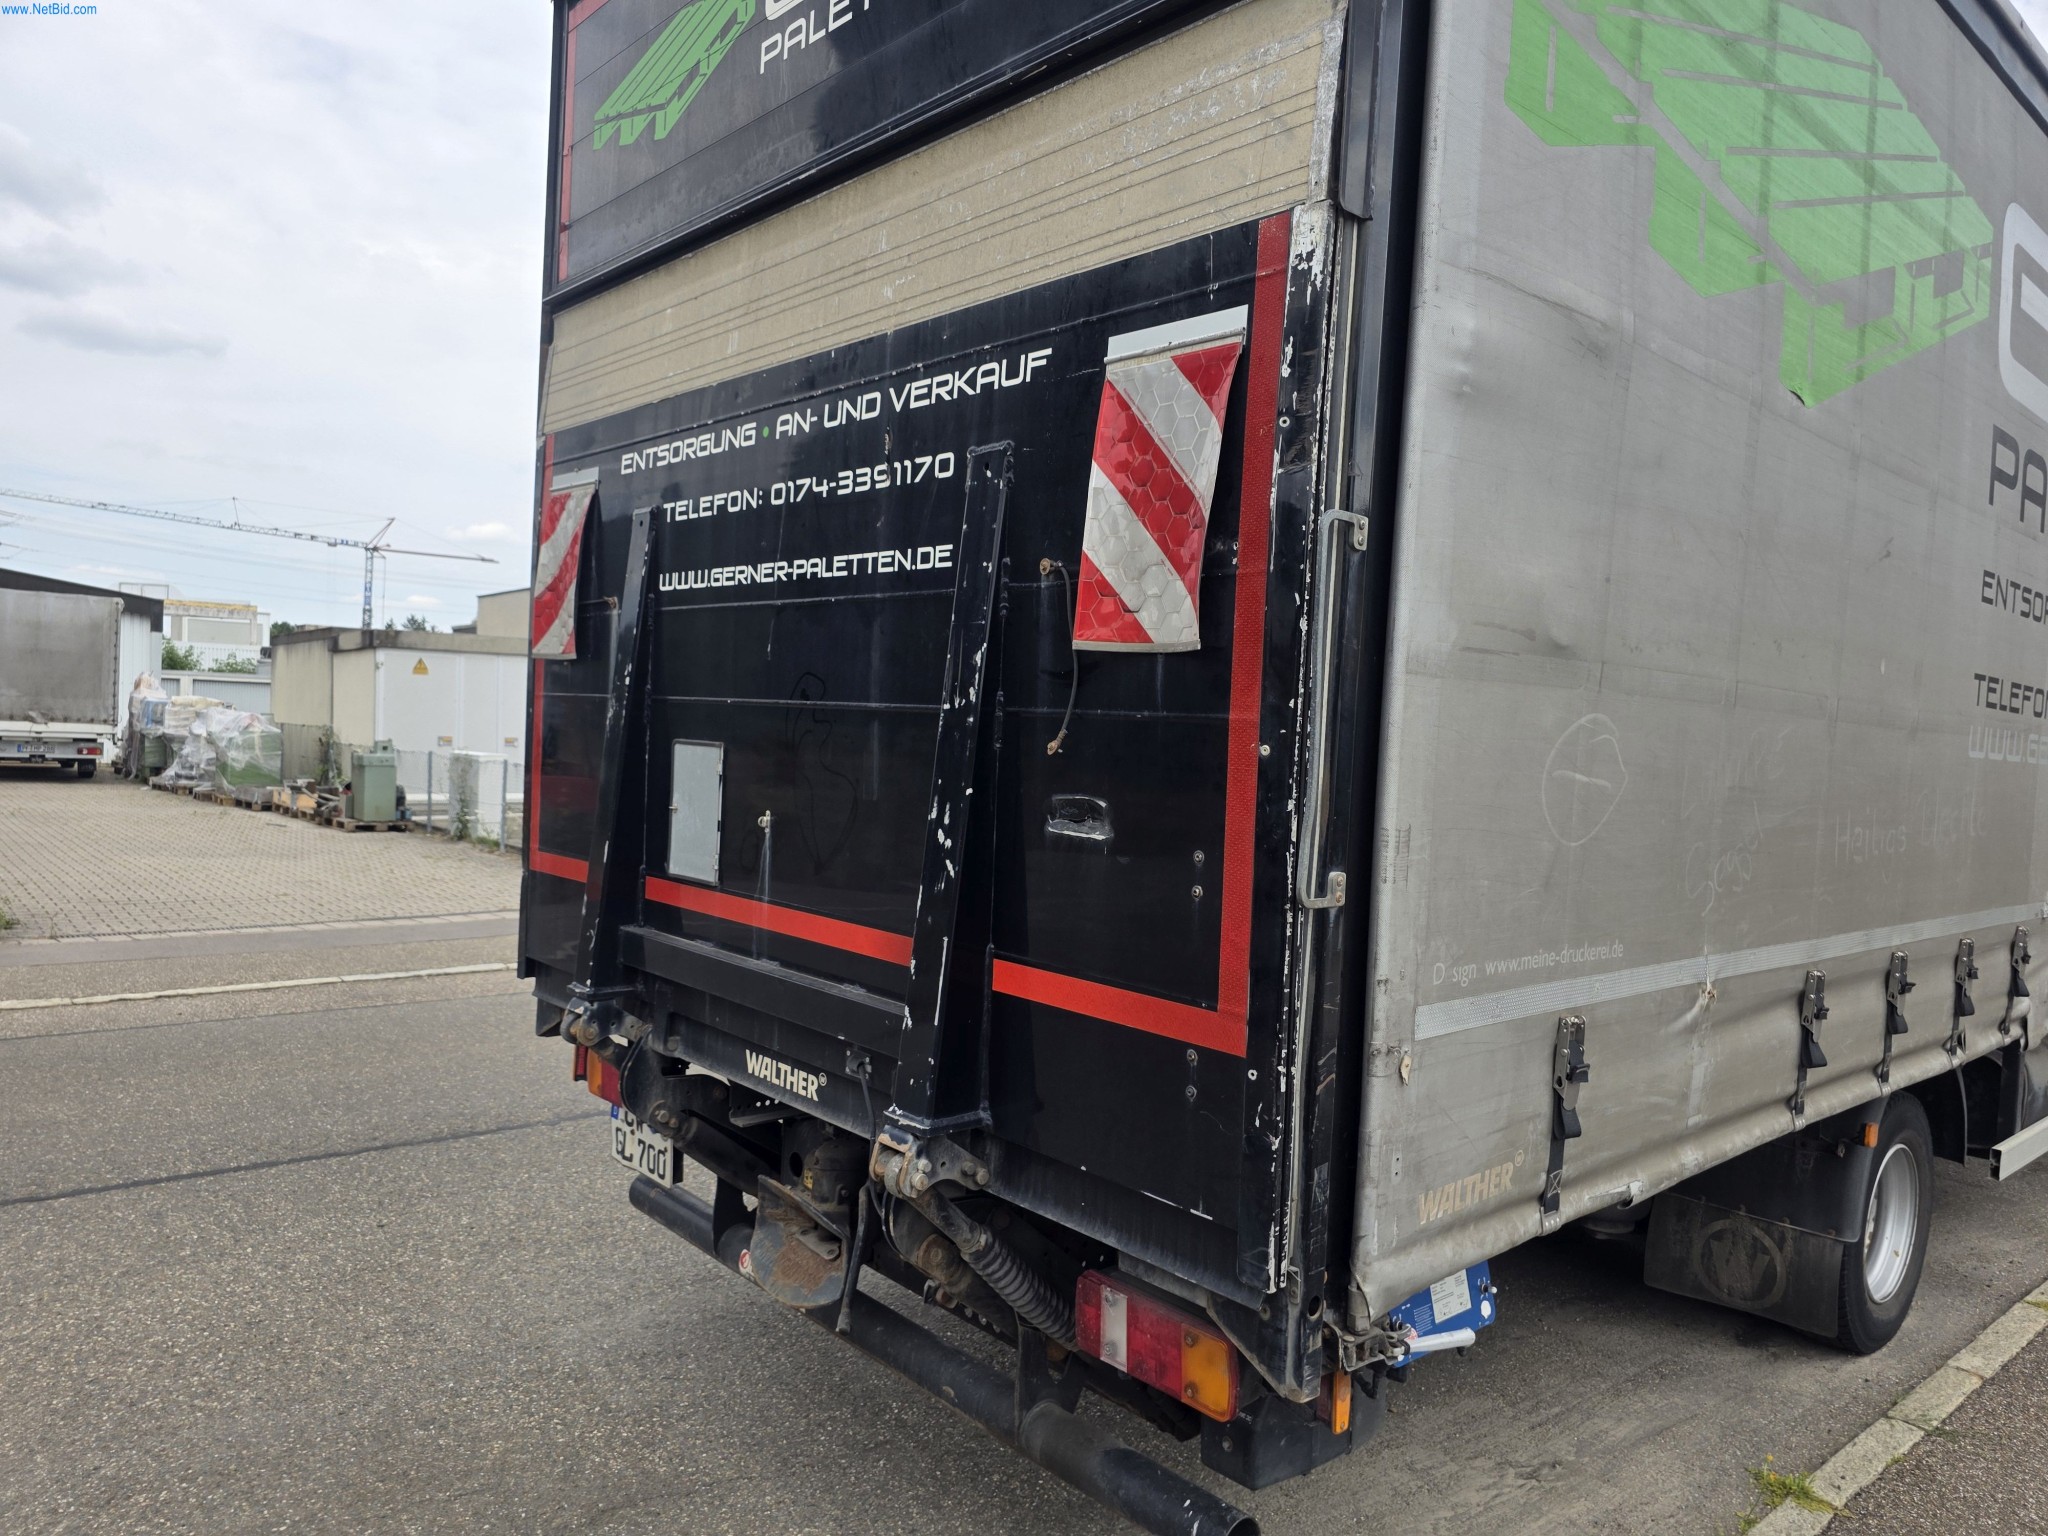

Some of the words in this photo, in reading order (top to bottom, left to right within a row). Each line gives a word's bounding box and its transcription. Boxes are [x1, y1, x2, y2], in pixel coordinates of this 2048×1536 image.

[760, 0, 869, 75] PALE
[620, 422, 757, 475] ENTSORGUNG
[776, 408, 818, 440] AN-
[823, 391, 881, 428] UND
[889, 347, 1053, 413] VERKAUF
[663, 487, 763, 523] TELEFON:
[771, 452, 955, 505] 0174-3391170
[1981, 569, 2048, 626] ENTSO
[1485, 939, 1625, 977] www.meine-druckerei.de
[746, 1048, 819, 1102] WALTHER
[637, 1138, 667, 1181] 700
[1418, 1161, 1514, 1226] WALTHER
